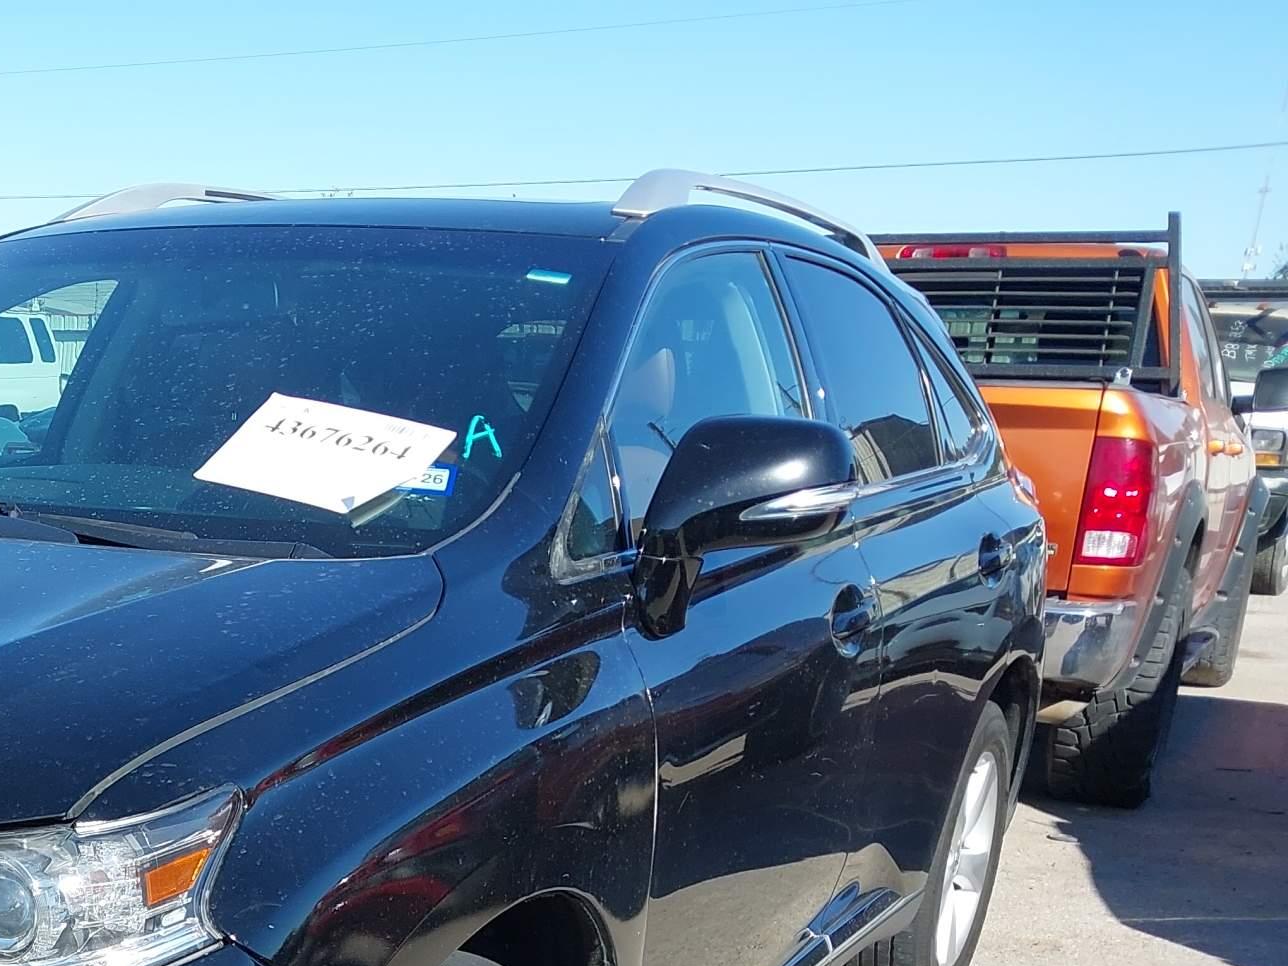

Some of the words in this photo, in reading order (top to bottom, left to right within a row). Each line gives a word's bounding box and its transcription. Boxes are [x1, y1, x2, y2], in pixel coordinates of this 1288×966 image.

[265, 418, 412, 460] 43676264
[464, 415, 503, 459] A
[421, 473, 444, 485] 26
